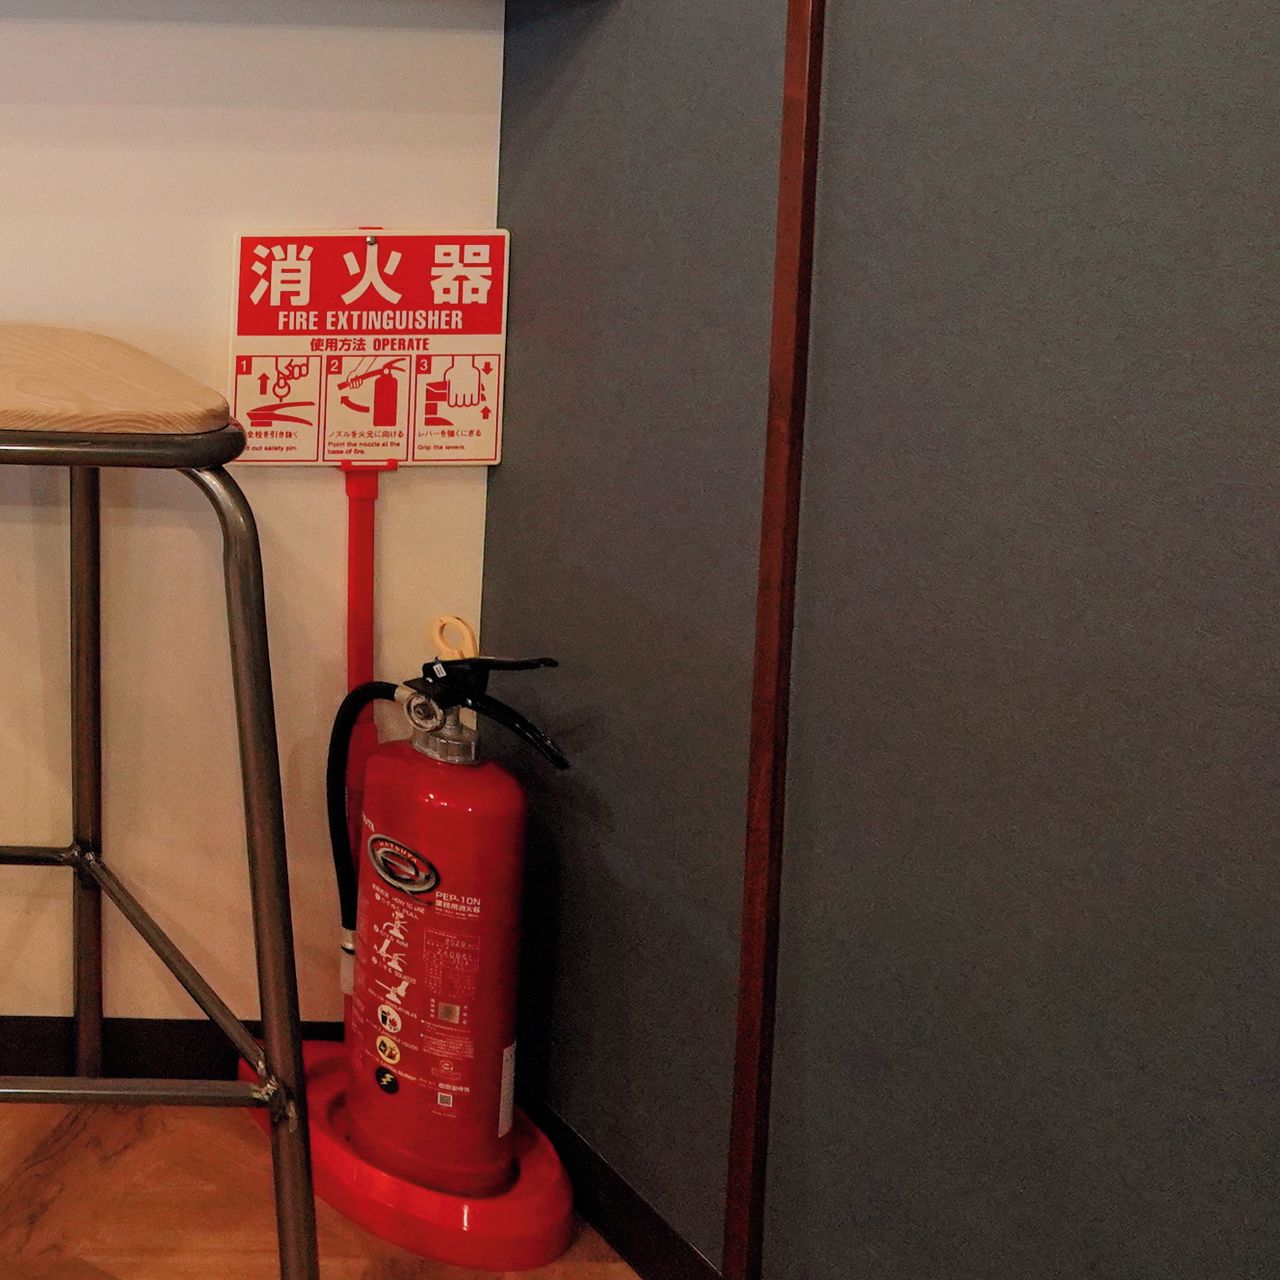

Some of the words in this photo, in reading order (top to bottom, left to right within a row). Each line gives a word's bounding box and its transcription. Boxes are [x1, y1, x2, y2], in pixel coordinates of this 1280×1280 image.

[249, 244, 493, 306] 消火器
[278, 311, 319, 331] FIRE
[326, 309, 464, 330] EXTINGUISHER
[310, 337, 367, 352] 使用方法
[373, 337, 430, 351] OPERATE
[240, 359, 247, 372] 1
[330, 360, 339, 372] 2
[420, 358, 428, 371] 3
